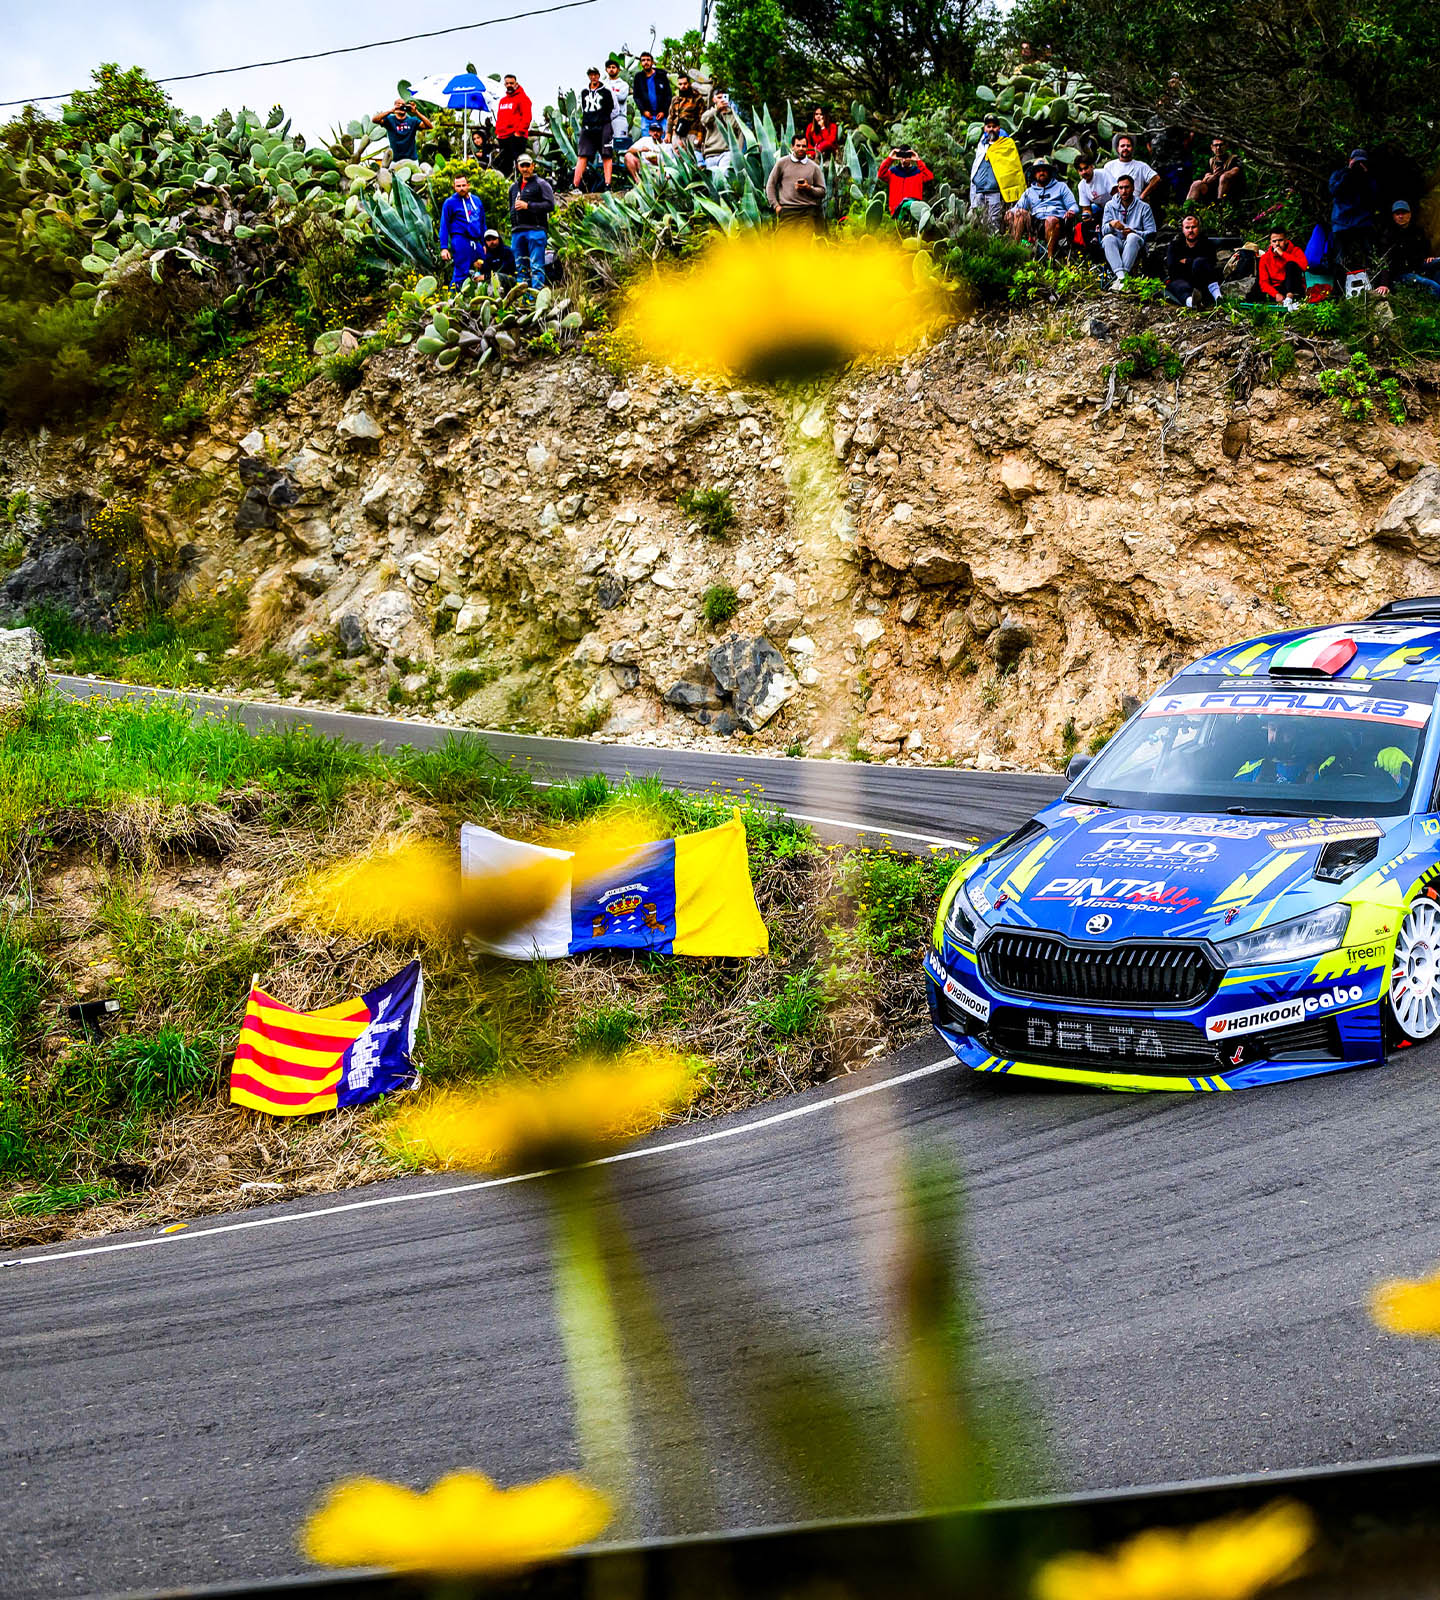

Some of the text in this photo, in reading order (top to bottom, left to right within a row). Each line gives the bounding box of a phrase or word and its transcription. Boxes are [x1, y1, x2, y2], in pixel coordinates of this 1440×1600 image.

[1200, 693, 1409, 718] FORUM8
[1036, 877, 1202, 914] PINTA rally
[1068, 896, 1177, 914] Motorsport
[1346, 945, 1386, 961] freem
[1304, 985, 1363, 1013] cabo
[1027, 1017, 1167, 1058] DELTA
